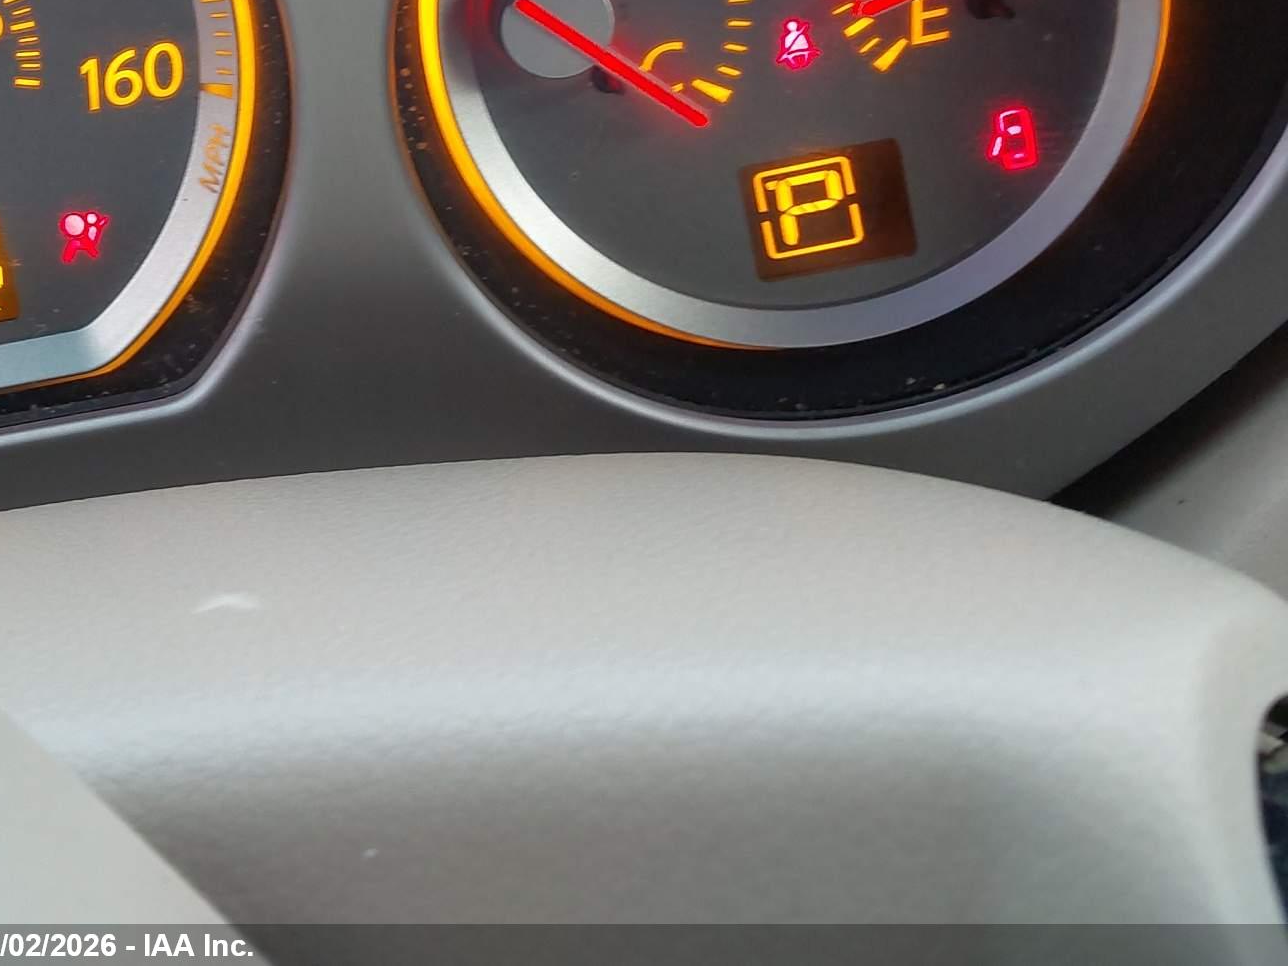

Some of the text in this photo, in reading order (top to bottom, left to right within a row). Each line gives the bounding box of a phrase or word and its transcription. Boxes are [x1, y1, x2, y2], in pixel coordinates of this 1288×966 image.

[79, 41, 185, 112] 160
[199, 123, 231, 193] MPH
[764, 169, 845, 246] P
